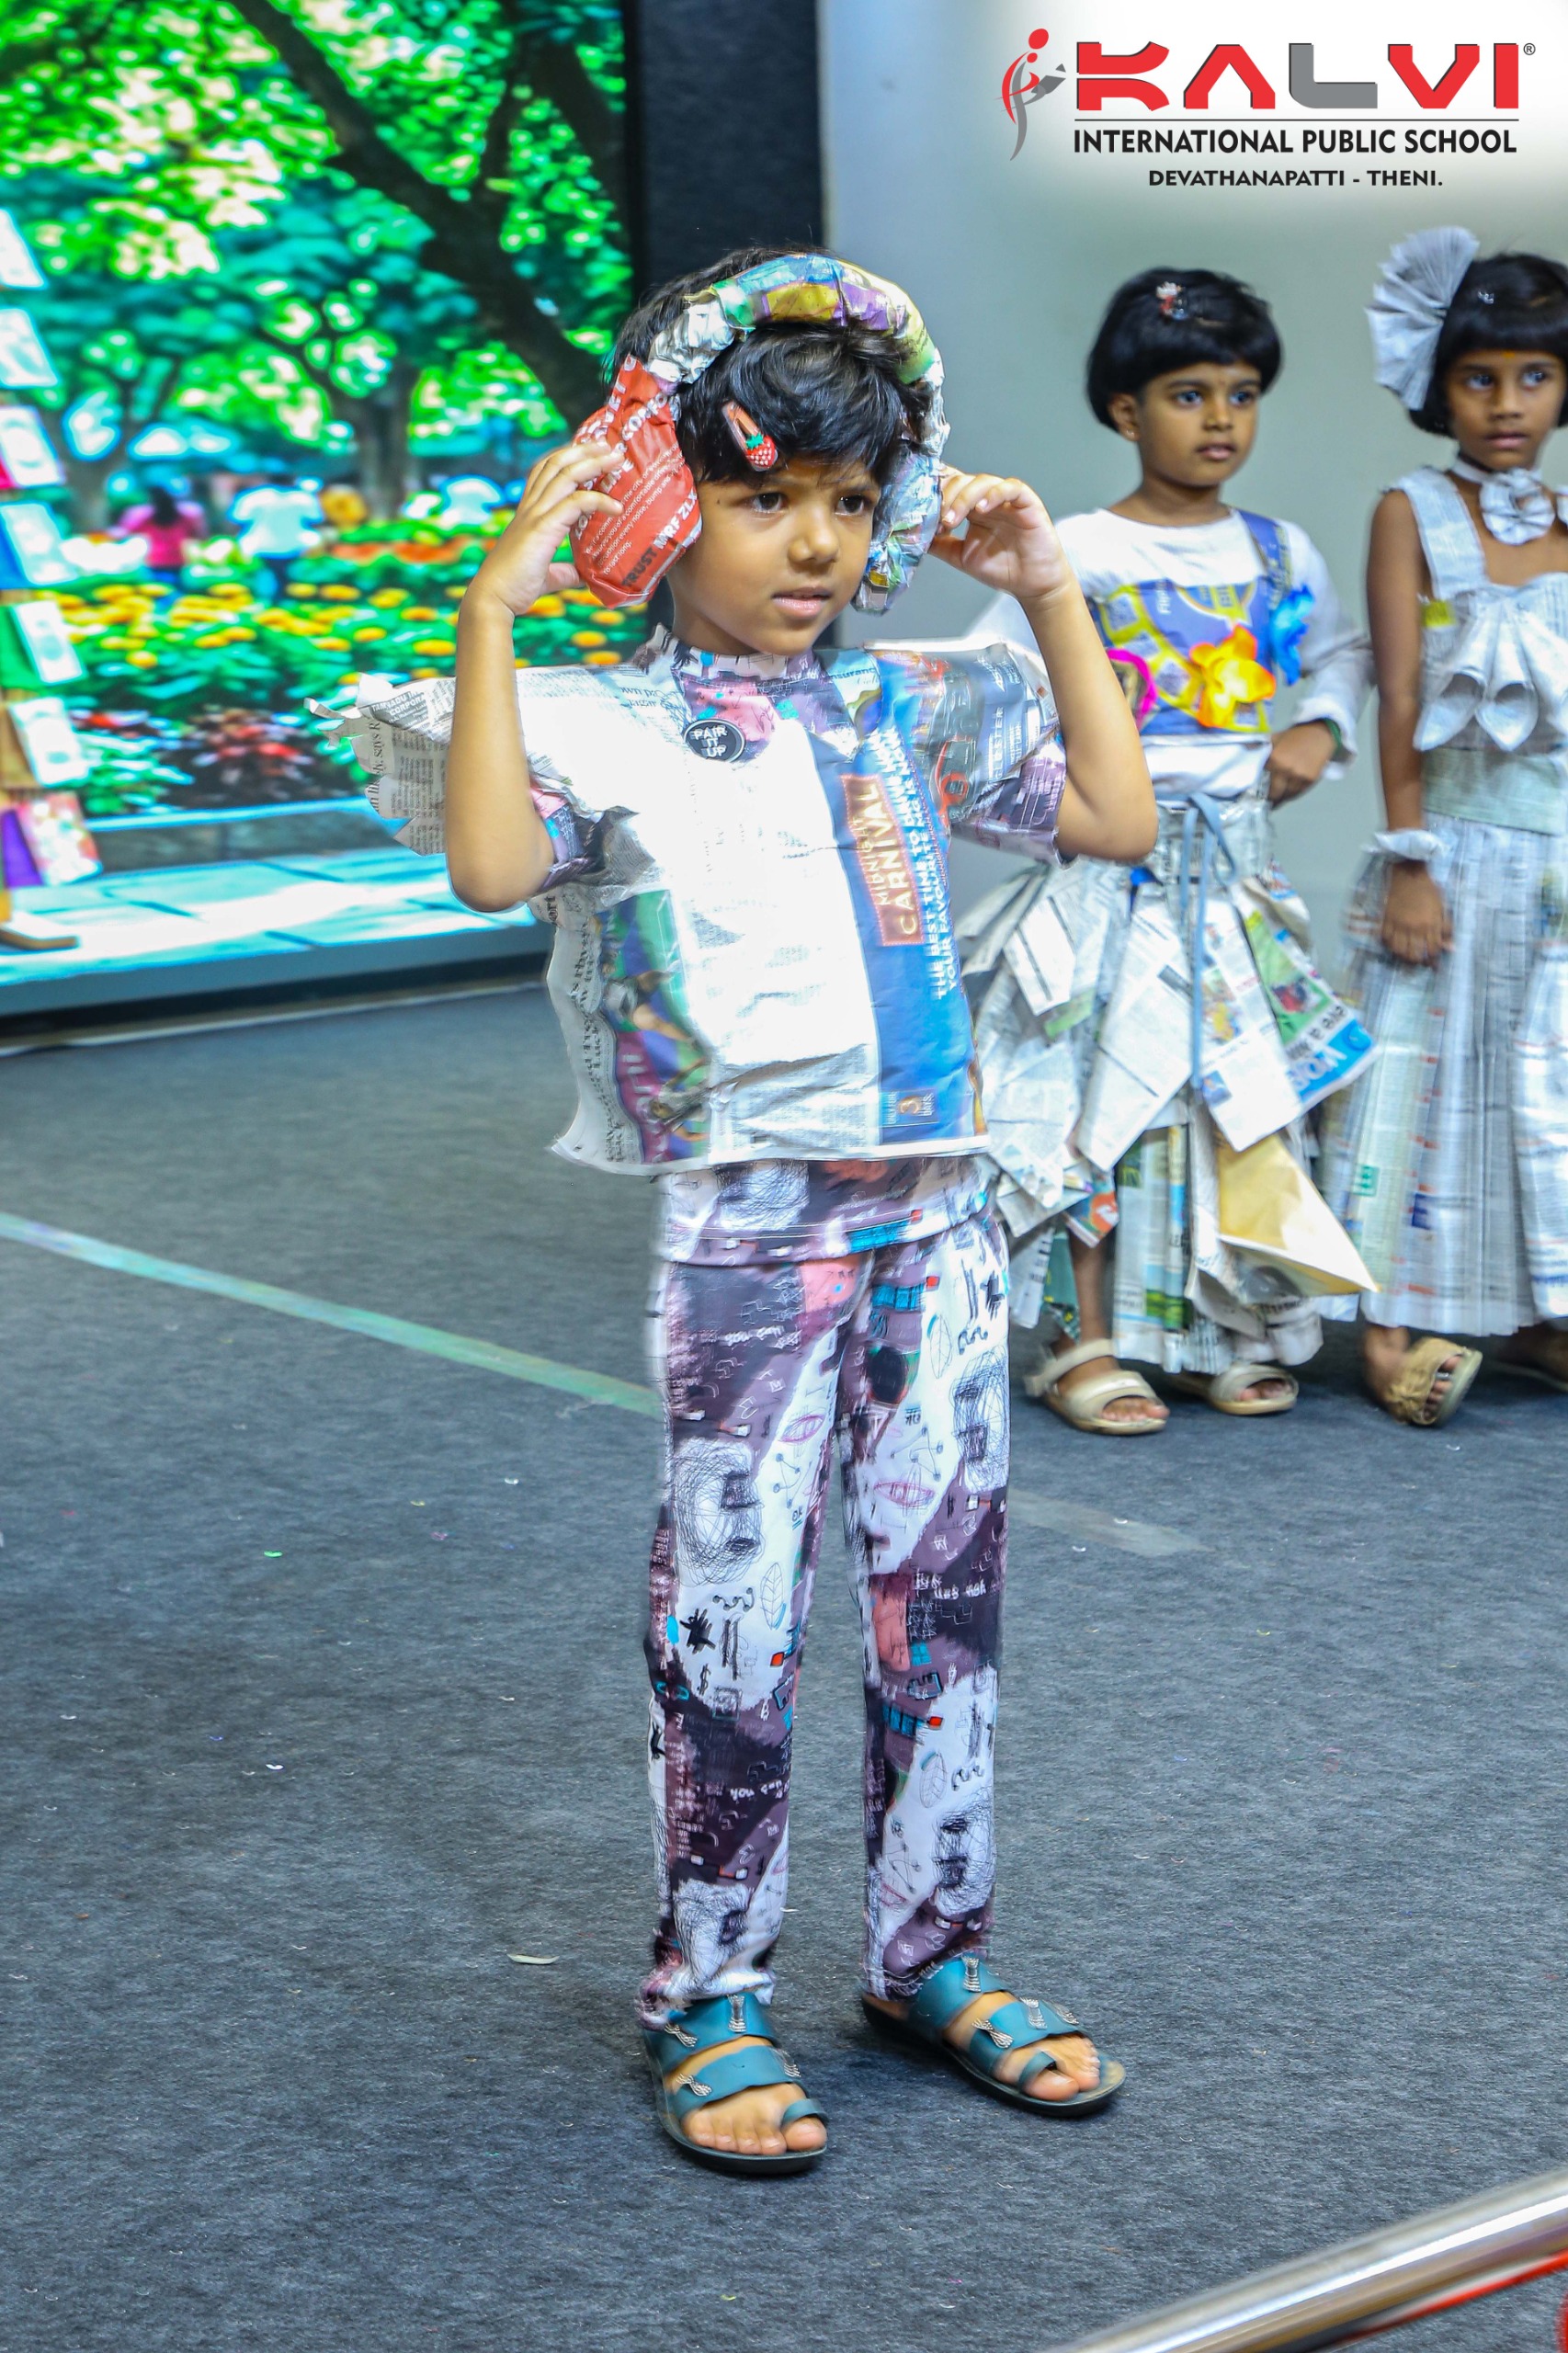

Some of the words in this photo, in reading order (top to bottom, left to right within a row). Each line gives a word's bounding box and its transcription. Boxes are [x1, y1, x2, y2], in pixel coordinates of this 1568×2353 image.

[619, 521, 634, 540] every
[646, 487, 663, 506] bump
[624, 480, 656, 516] comfortable
[621, 547, 657, 587] TRUST
[653, 515, 682, 550] MRF
[692, 725, 728, 741] PAIR
[704, 745, 727, 757] UP
[852, 817, 891, 906] MIDNIGHT
[861, 784, 918, 936] CARNIVAL
[905, 831, 927, 857] TO
[916, 859, 937, 905] TIME
[924, 909, 941, 956] BEST
[926, 956, 949, 1000] THE
[938, 935, 958, 991] YOUR
[730, 1788, 755, 1802] you
